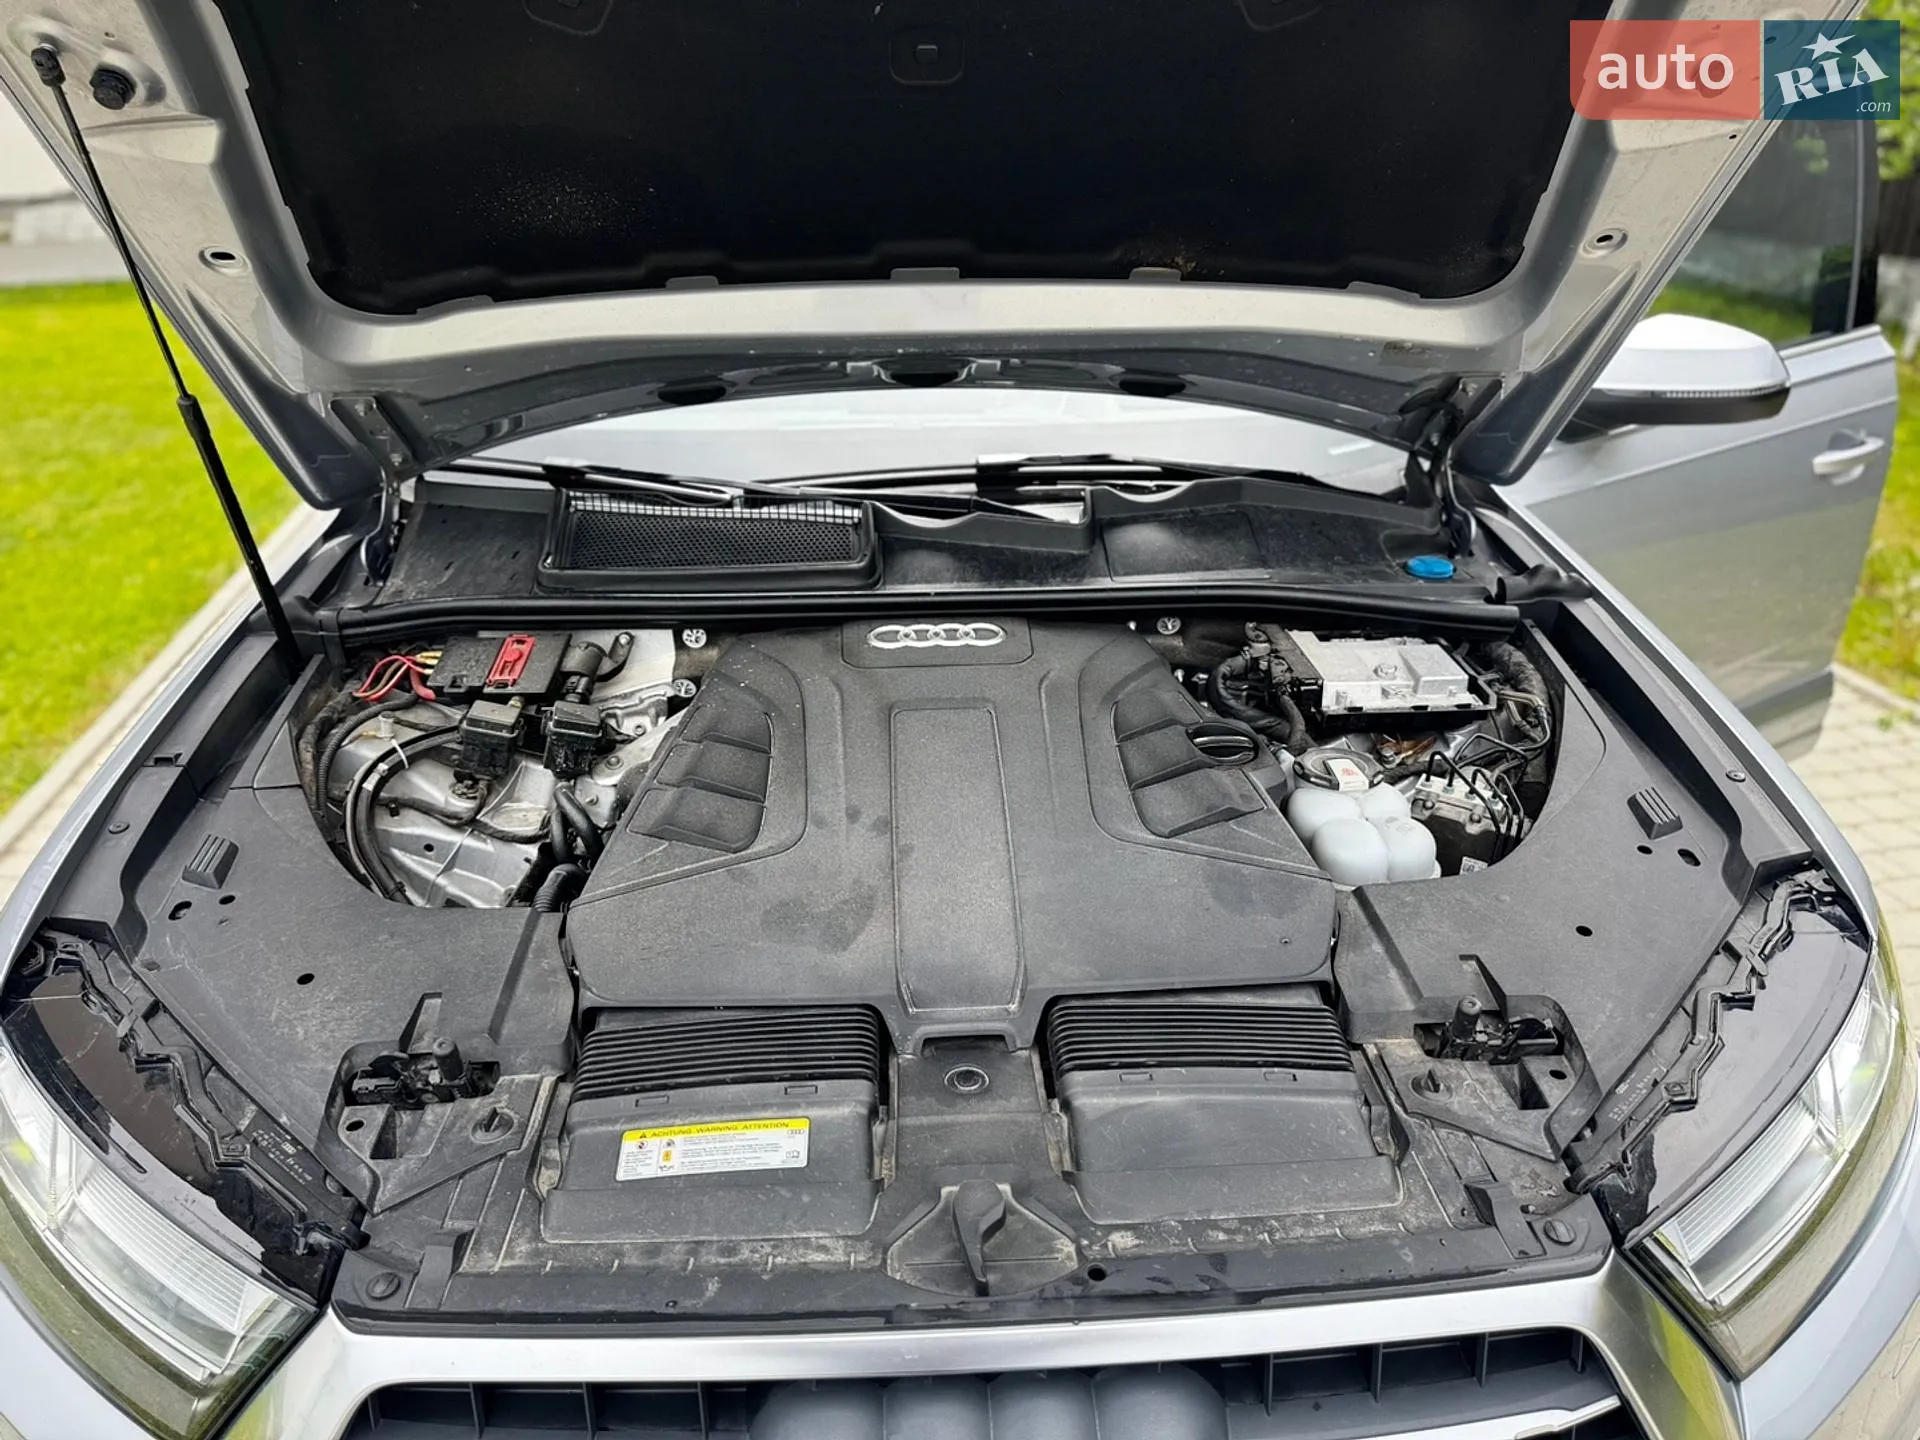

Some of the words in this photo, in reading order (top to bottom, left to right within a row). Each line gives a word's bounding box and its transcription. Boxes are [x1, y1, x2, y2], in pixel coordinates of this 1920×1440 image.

[651, 1128, 692, 1138] ACHTUNG
[696, 1125, 738, 1135] WARNING
[742, 1121, 790, 1131] ATTENTION
